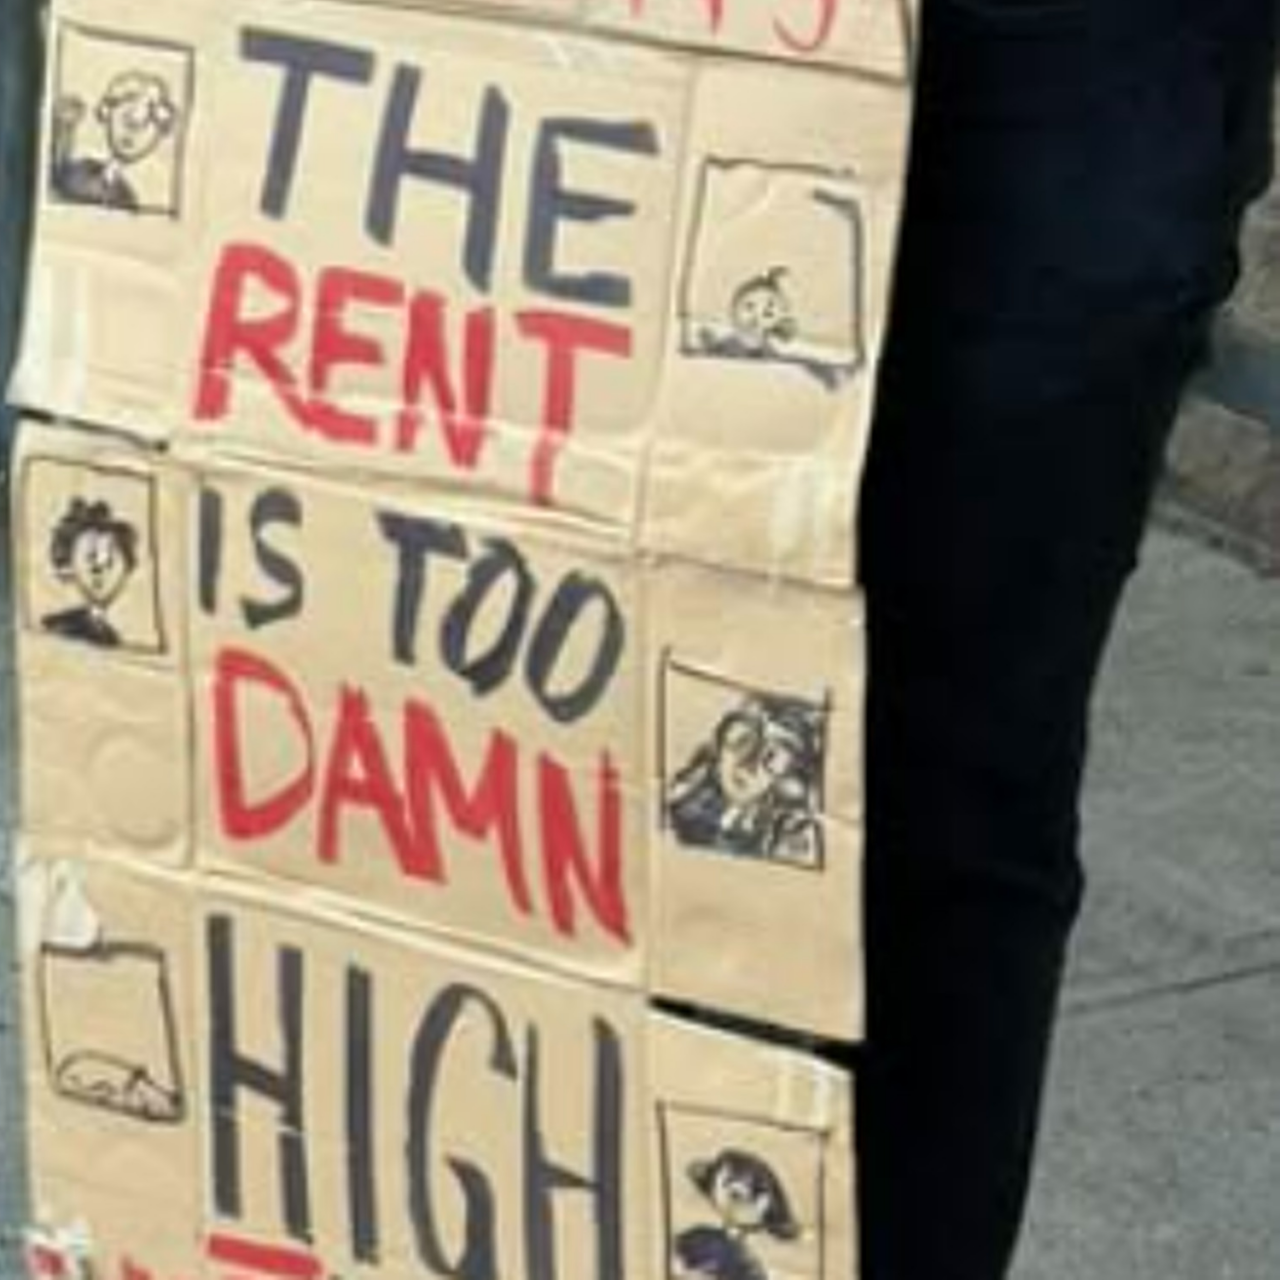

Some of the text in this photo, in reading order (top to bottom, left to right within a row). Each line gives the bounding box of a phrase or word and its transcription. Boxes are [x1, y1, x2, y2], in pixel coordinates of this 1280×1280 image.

[238, 26, 660, 310] THE
[190, 242, 634, 510] RENT
[196, 488, 628, 726] IS TOO
[210, 646, 634, 950] DAMN
[205, 914, 626, 1280] HIGH
